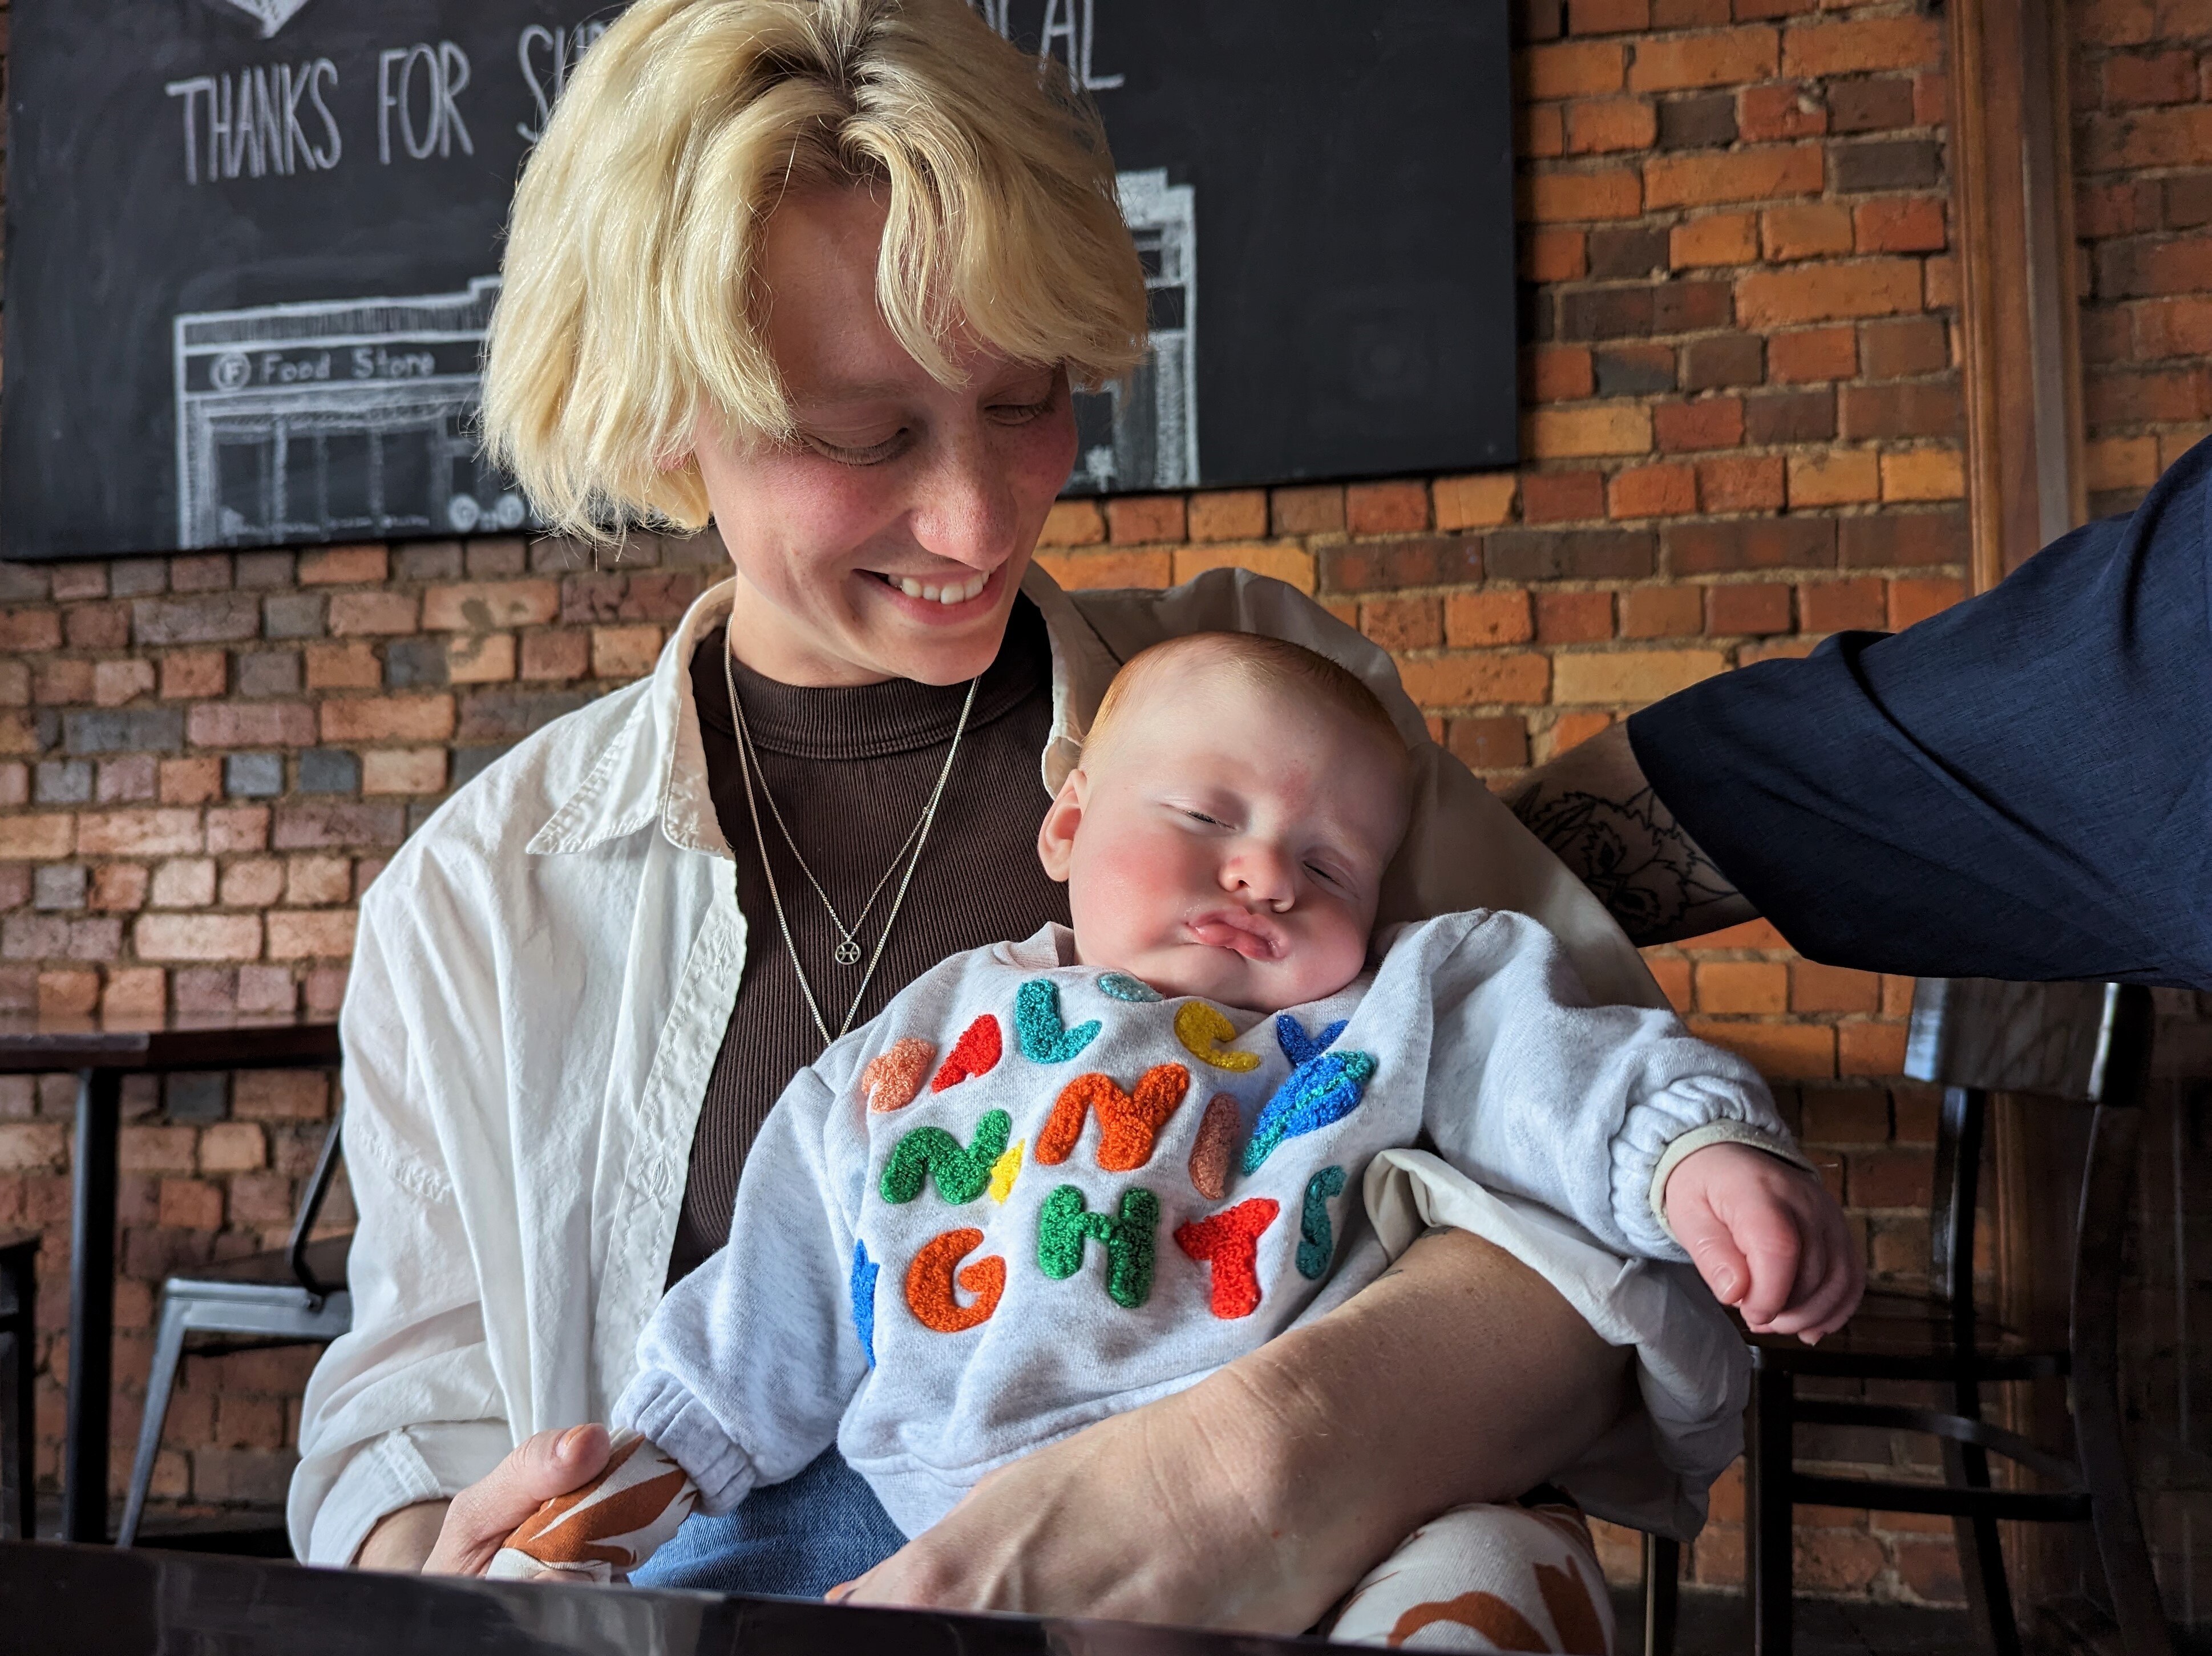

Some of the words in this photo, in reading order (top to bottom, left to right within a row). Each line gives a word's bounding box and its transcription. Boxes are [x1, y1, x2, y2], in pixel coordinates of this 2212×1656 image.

[164, 58, 342, 186] THANKS
[377, 41, 474, 165] FOR
[259, 350, 331, 384] Food
[351, 346, 435, 380] Store
